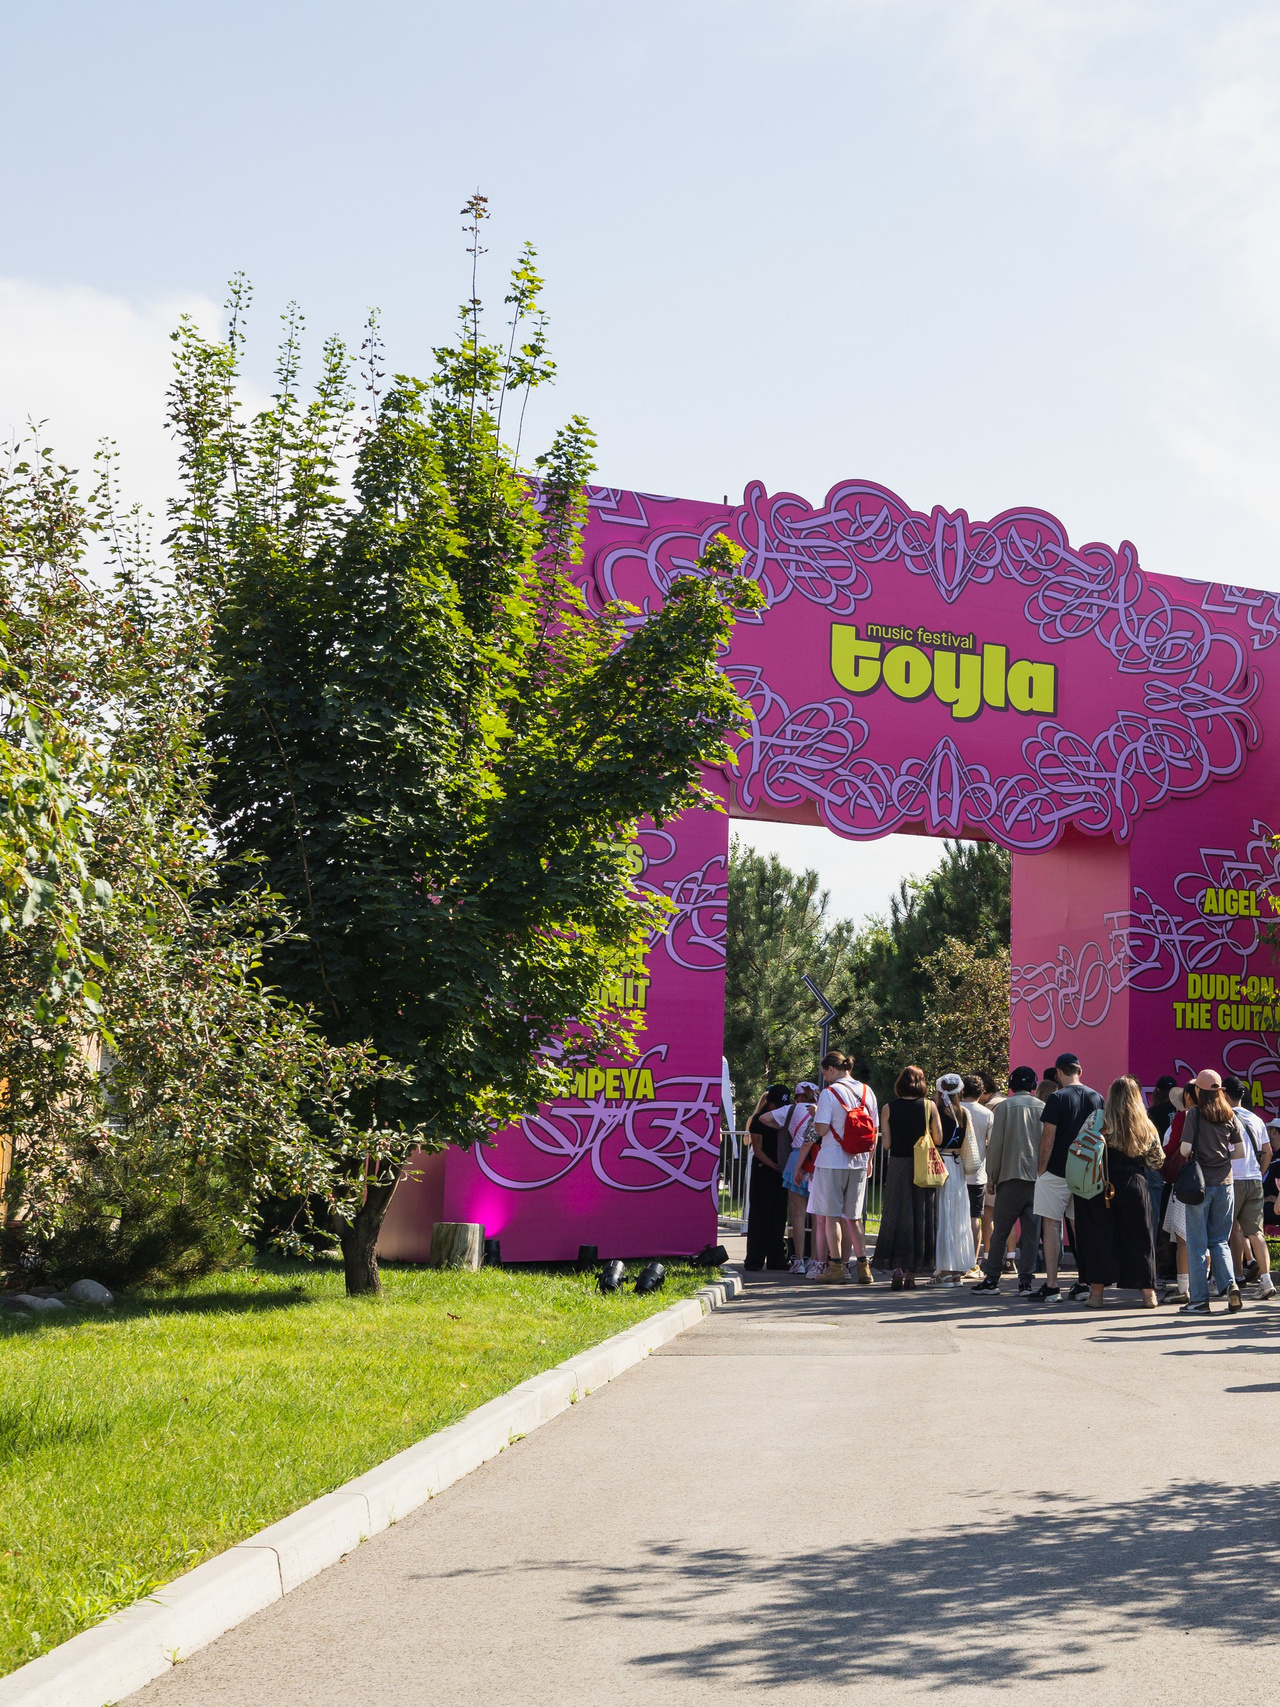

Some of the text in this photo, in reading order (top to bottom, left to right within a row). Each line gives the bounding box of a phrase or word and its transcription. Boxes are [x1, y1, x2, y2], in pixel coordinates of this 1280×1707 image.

[867, 624, 974, 650] music festival
[830, 623, 1056, 719] toyla
[1203, 887, 1261, 917] AIGEL
[1187, 973, 1241, 1001] DUDE
[1172, 1002, 1212, 1030] THE
[547, 1067, 656, 1100] MPEYA
